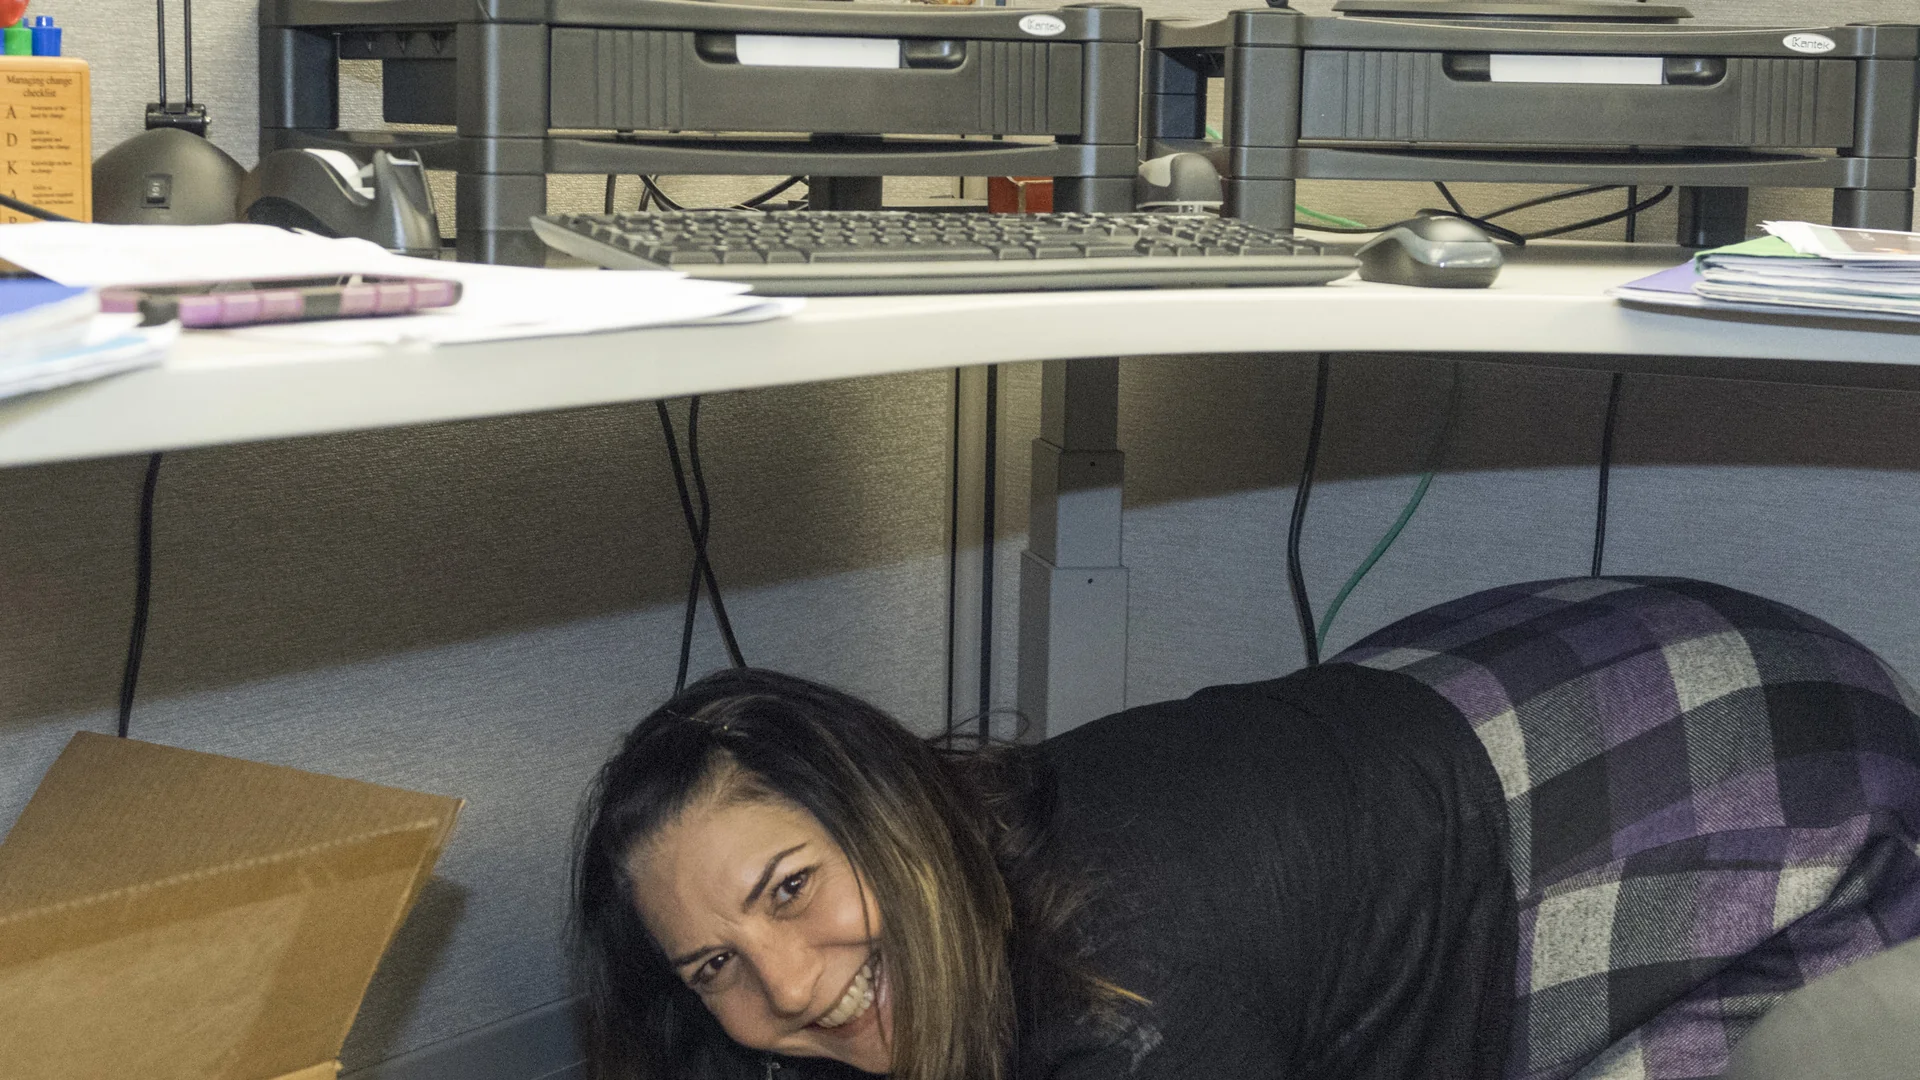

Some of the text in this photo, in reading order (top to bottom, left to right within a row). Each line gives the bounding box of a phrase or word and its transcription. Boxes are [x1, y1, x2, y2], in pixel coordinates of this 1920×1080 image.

[1791, 36, 1830, 50] Kantek
[6, 75, 72, 87] Managing change
[22, 88, 57, 98] checklist
[6, 105, 16, 119] A
[6, 132, 18, 147] D
[7, 160, 17, 174] K
